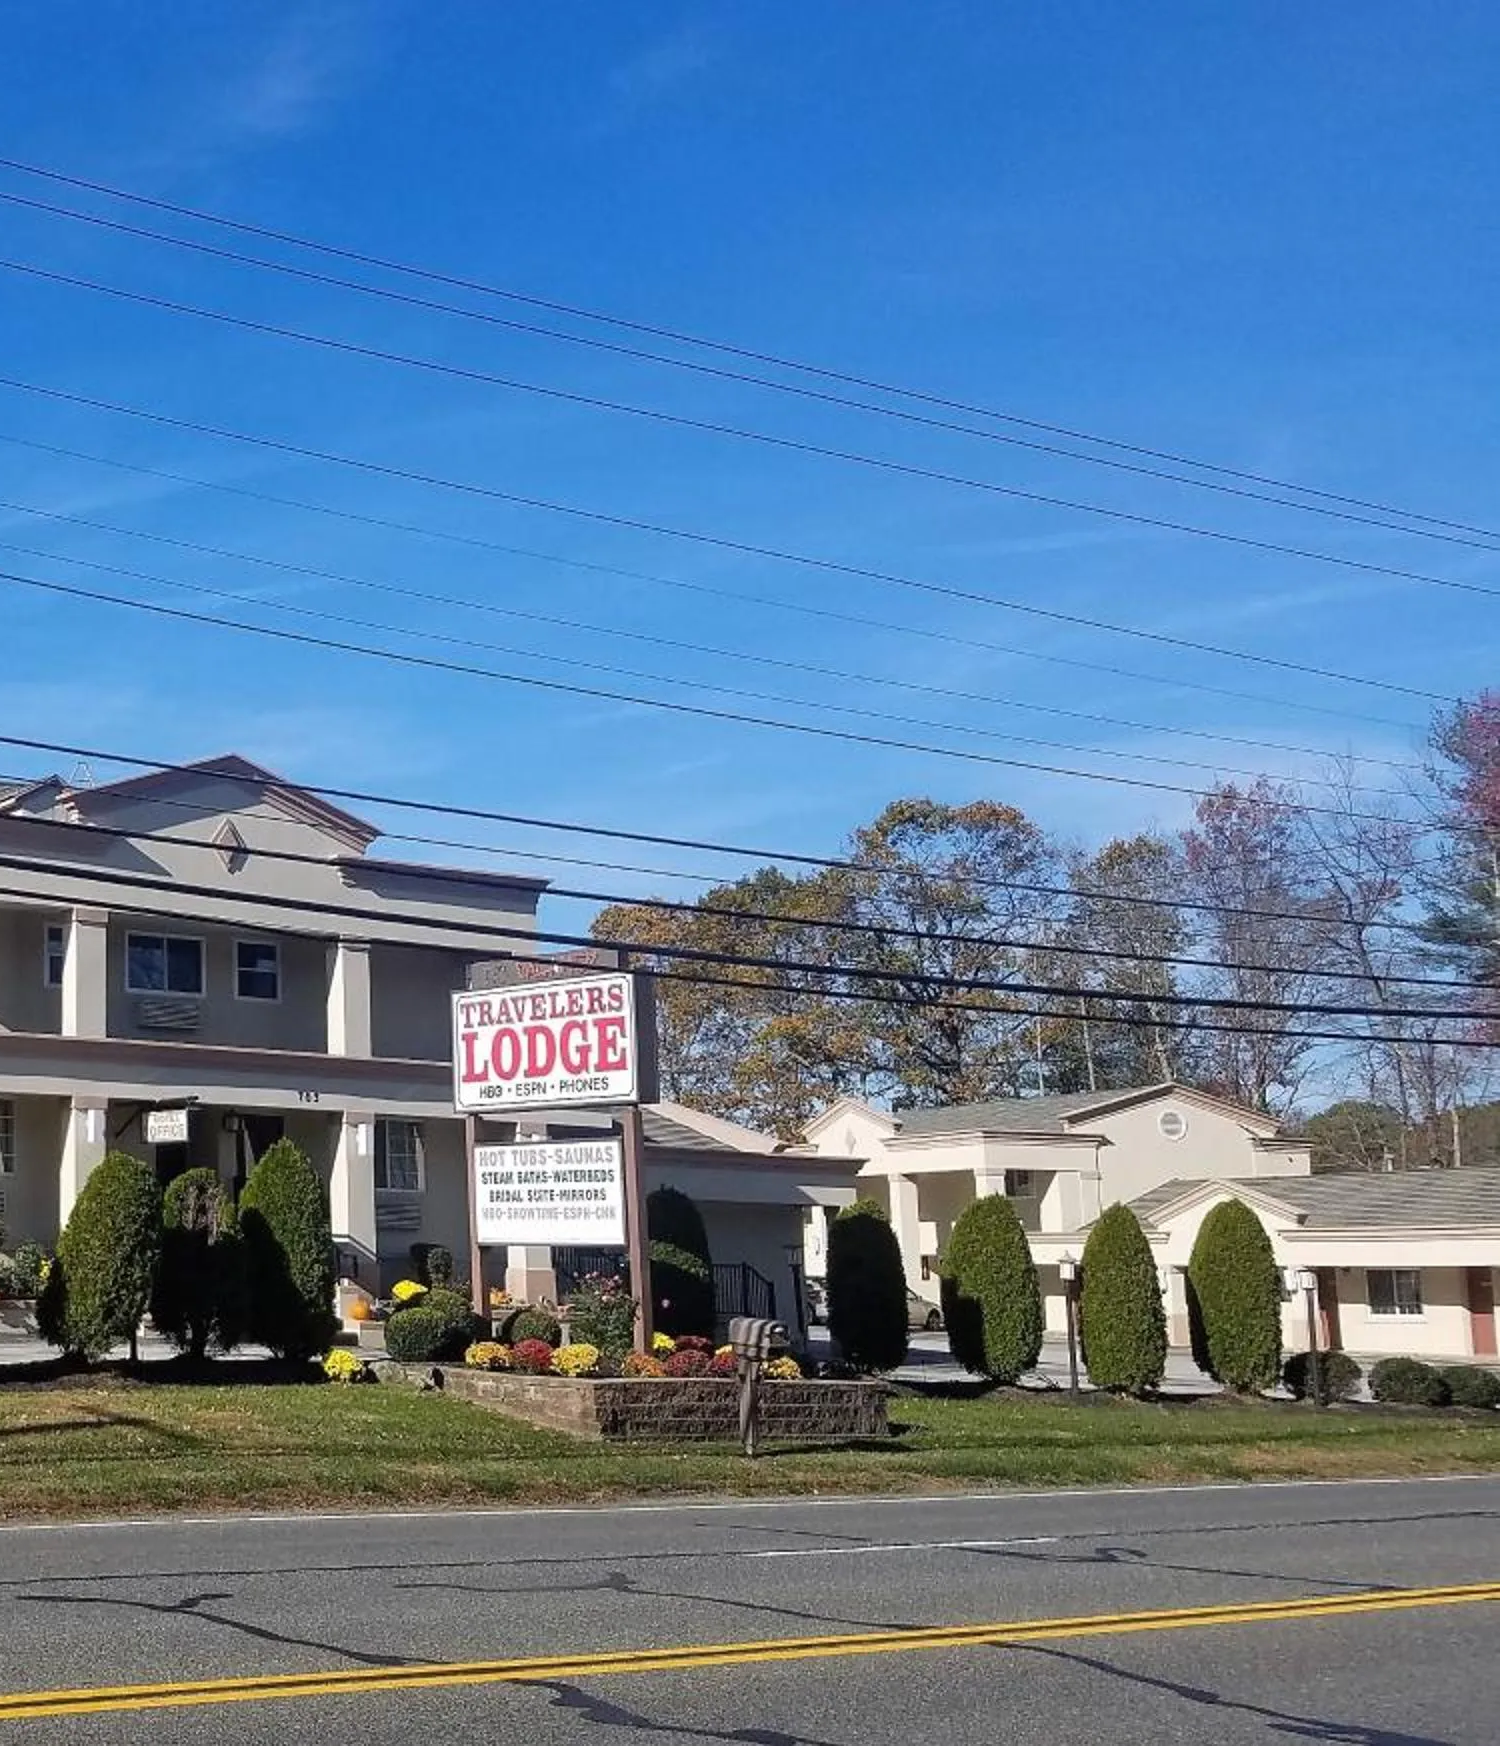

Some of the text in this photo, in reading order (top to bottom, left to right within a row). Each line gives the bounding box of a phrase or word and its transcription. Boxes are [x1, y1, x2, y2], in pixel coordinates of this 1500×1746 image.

[460, 983, 624, 1028] TRAVELERS
[461, 1016, 628, 1083] LODGE
[515, 1080, 547, 1097] ESPN
[559, 1076, 610, 1093] PHONES
[150, 1123, 185, 1139] OFFICE
[479, 1150, 506, 1167] HOT
[481, 1171, 514, 1185] STEAM
[489, 1189, 523, 1203] BRIDAL
